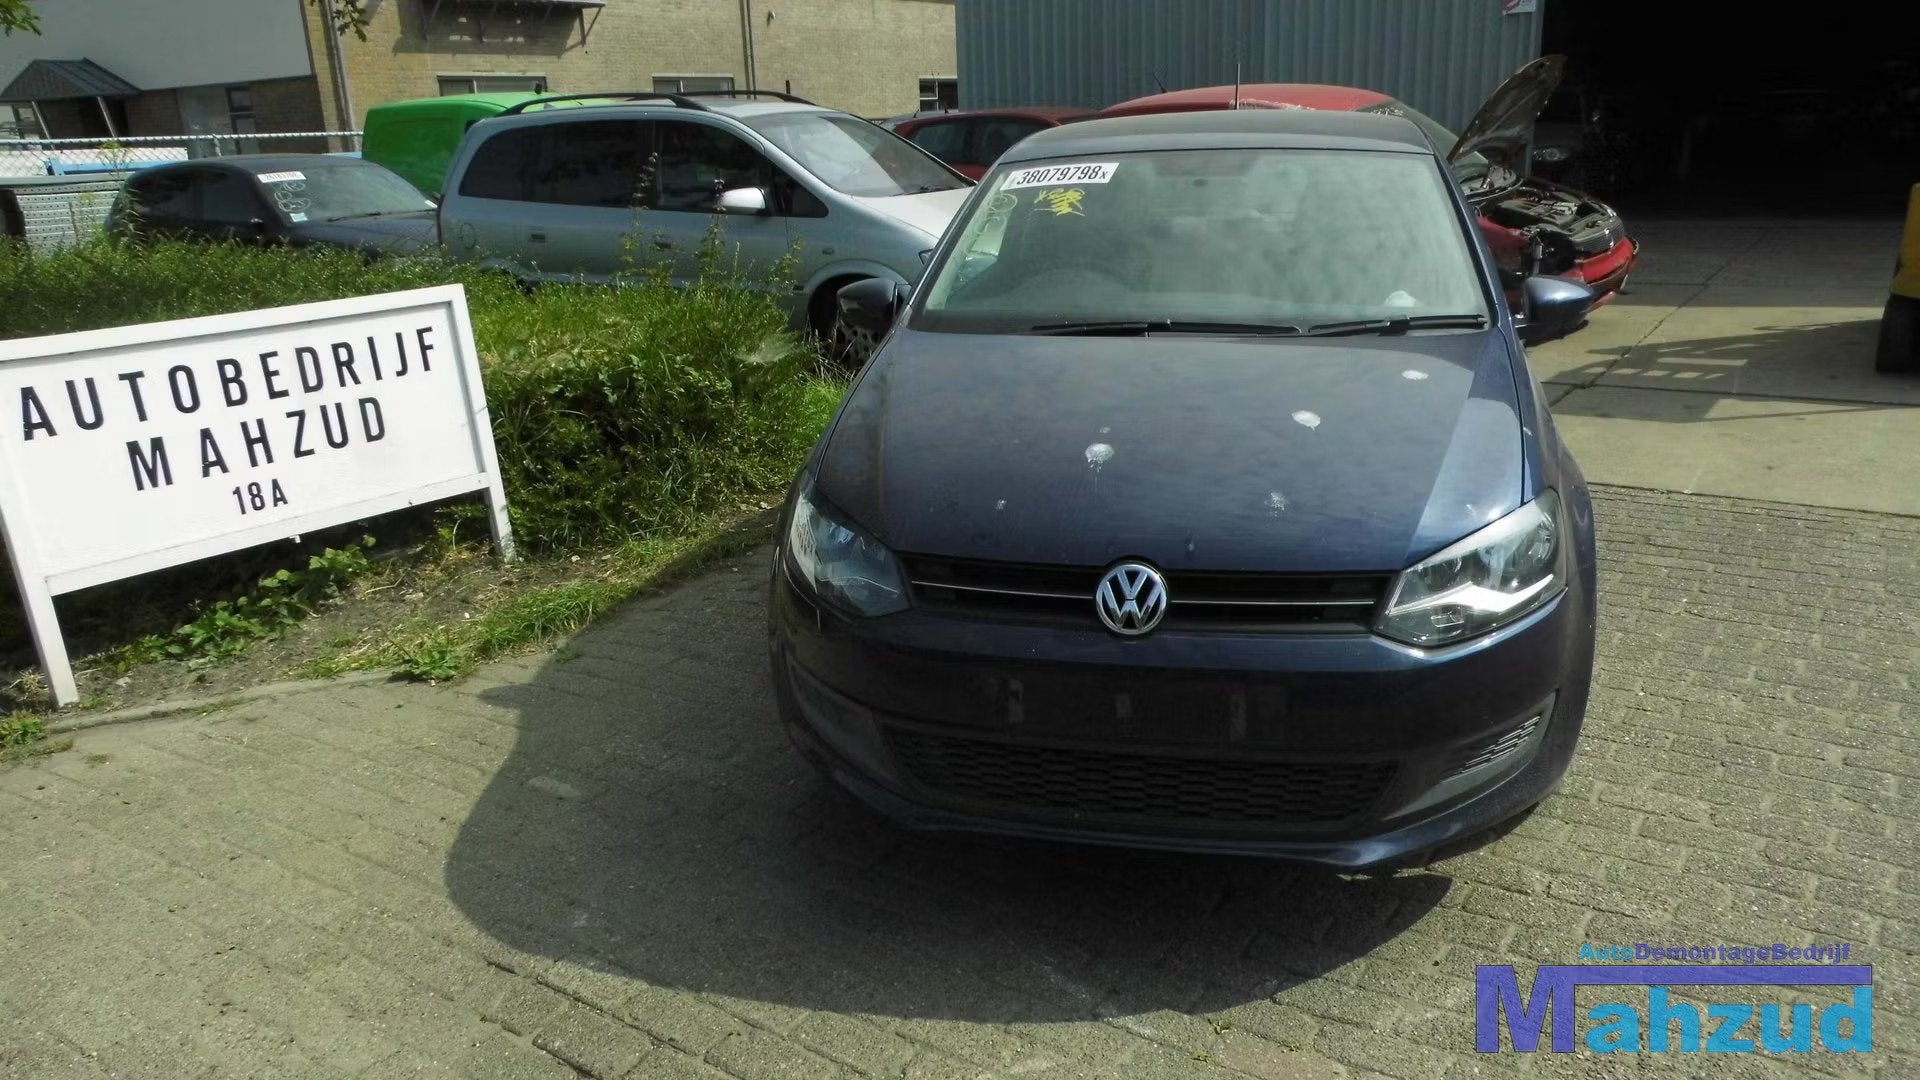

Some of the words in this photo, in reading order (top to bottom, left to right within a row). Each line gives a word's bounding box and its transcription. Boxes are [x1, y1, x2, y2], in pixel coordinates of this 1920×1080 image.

[20, 326, 435, 441] AUTOBEDRIJF
[126, 397, 385, 491] MAHZUD
[232, 478, 288, 515] 18A
[1099, 562, 1164, 632] VW
